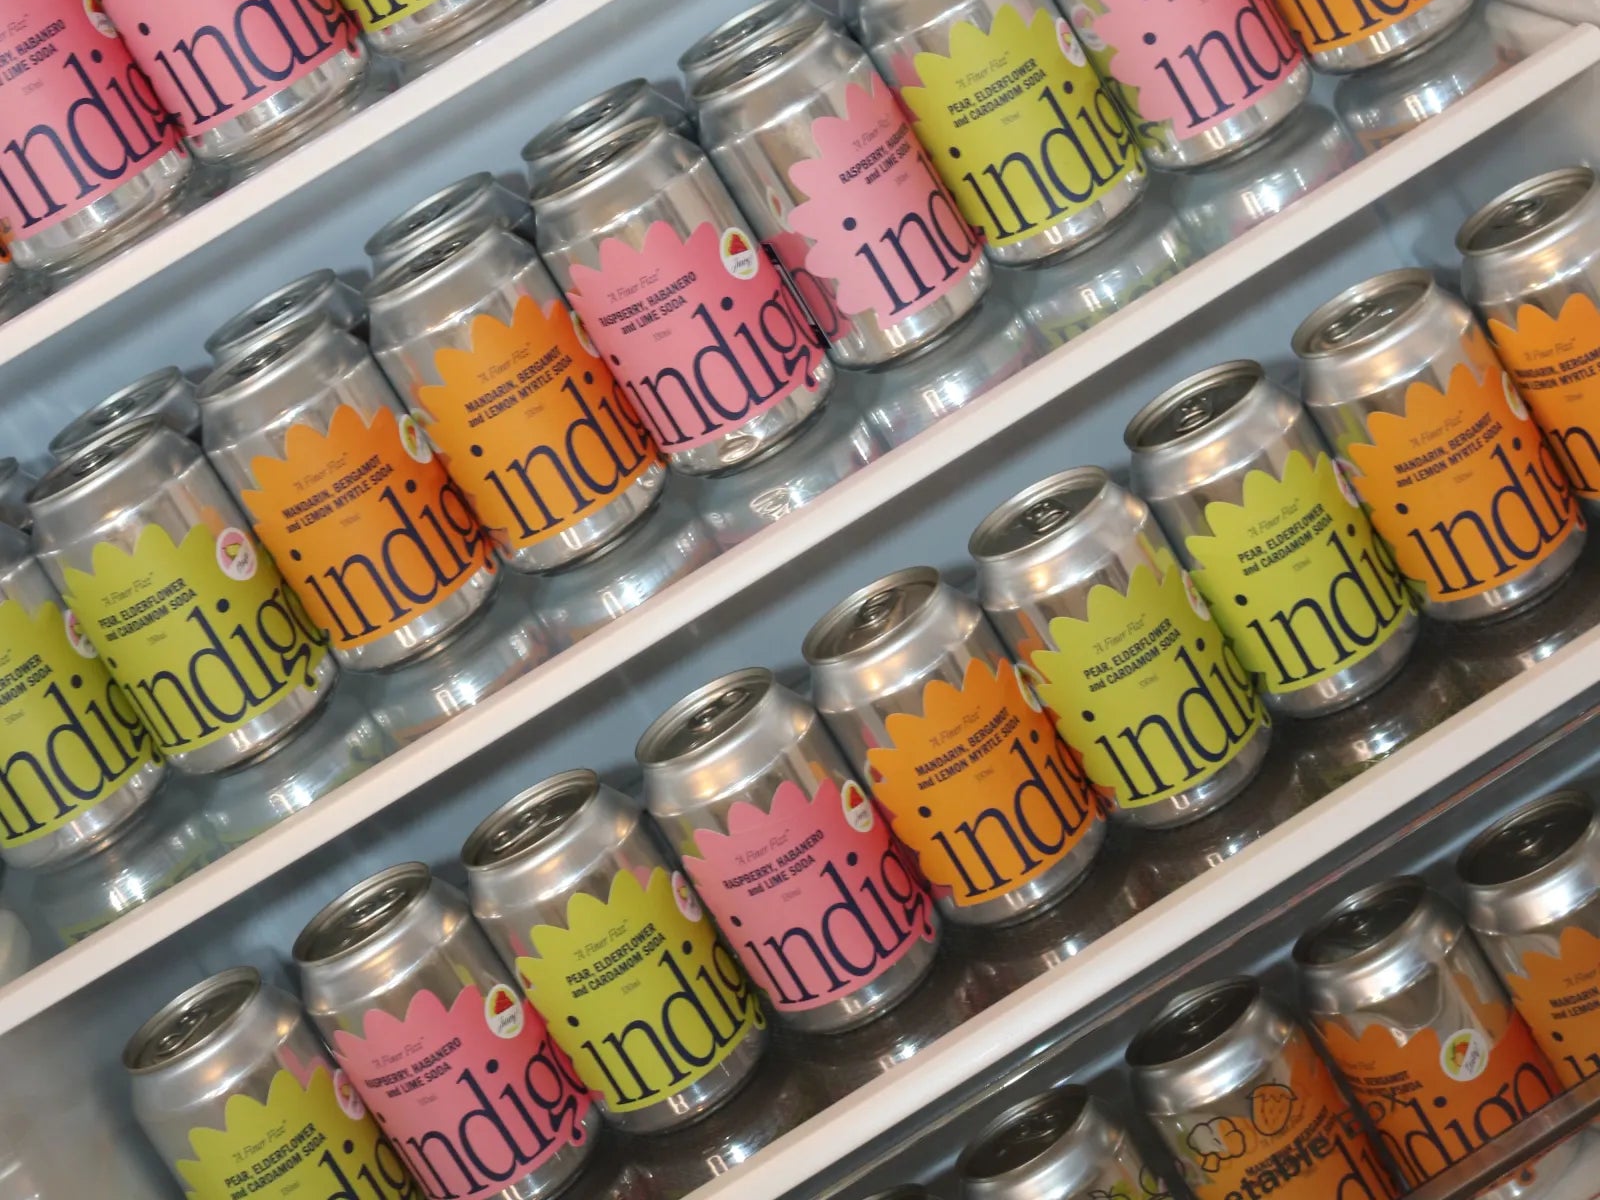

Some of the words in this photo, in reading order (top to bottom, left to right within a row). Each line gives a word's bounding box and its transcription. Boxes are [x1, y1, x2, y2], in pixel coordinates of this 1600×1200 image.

[968, 83, 1023, 121] CARDAMOM
[1022, 68, 1047, 90] SODA
[973, 57, 1038, 102] ELDERFLOWER
[0, 49, 183, 228] ndig
[949, 81, 1143, 240] indig
[635, 308, 661, 327] LIME
[658, 294, 687, 315] SODA
[551, 354, 573, 376] SODA
[1481, 421, 1503, 443] SODA
[1259, 530, 1313, 568] CARDAMOM
[1311, 513, 1333, 536] SODA
[1265, 503, 1325, 550] ELDERFLOWER
[1395, 436, 1581, 595] indig
[291, 479, 496, 642] indig
[1105, 646, 1160, 684] CARDAMOM
[1158, 628, 1181, 651] SODA
[1111, 618, 1172, 666] ELDERFLOWER
[26, 663, 53, 687] SODA
[1082, 638, 1269, 801] indig
[0, 673, 160, 840] ndig
[919, 730, 1108, 898] indig
[763, 870, 789, 889] LIME
[787, 854, 816, 876] SODA
[592, 922, 657, 972] ELDERFLOWER
[731, 852, 932, 1005] indig
[587, 951, 643, 991] CARDAMOM
[641, 932, 666, 957] SODA
[567, 941, 762, 1104] indig
[246, 1152, 303, 1193] CARDAMOM
[301, 1131, 327, 1157] SODA
[250, 1122, 317, 1175] ELDERFLOWER
